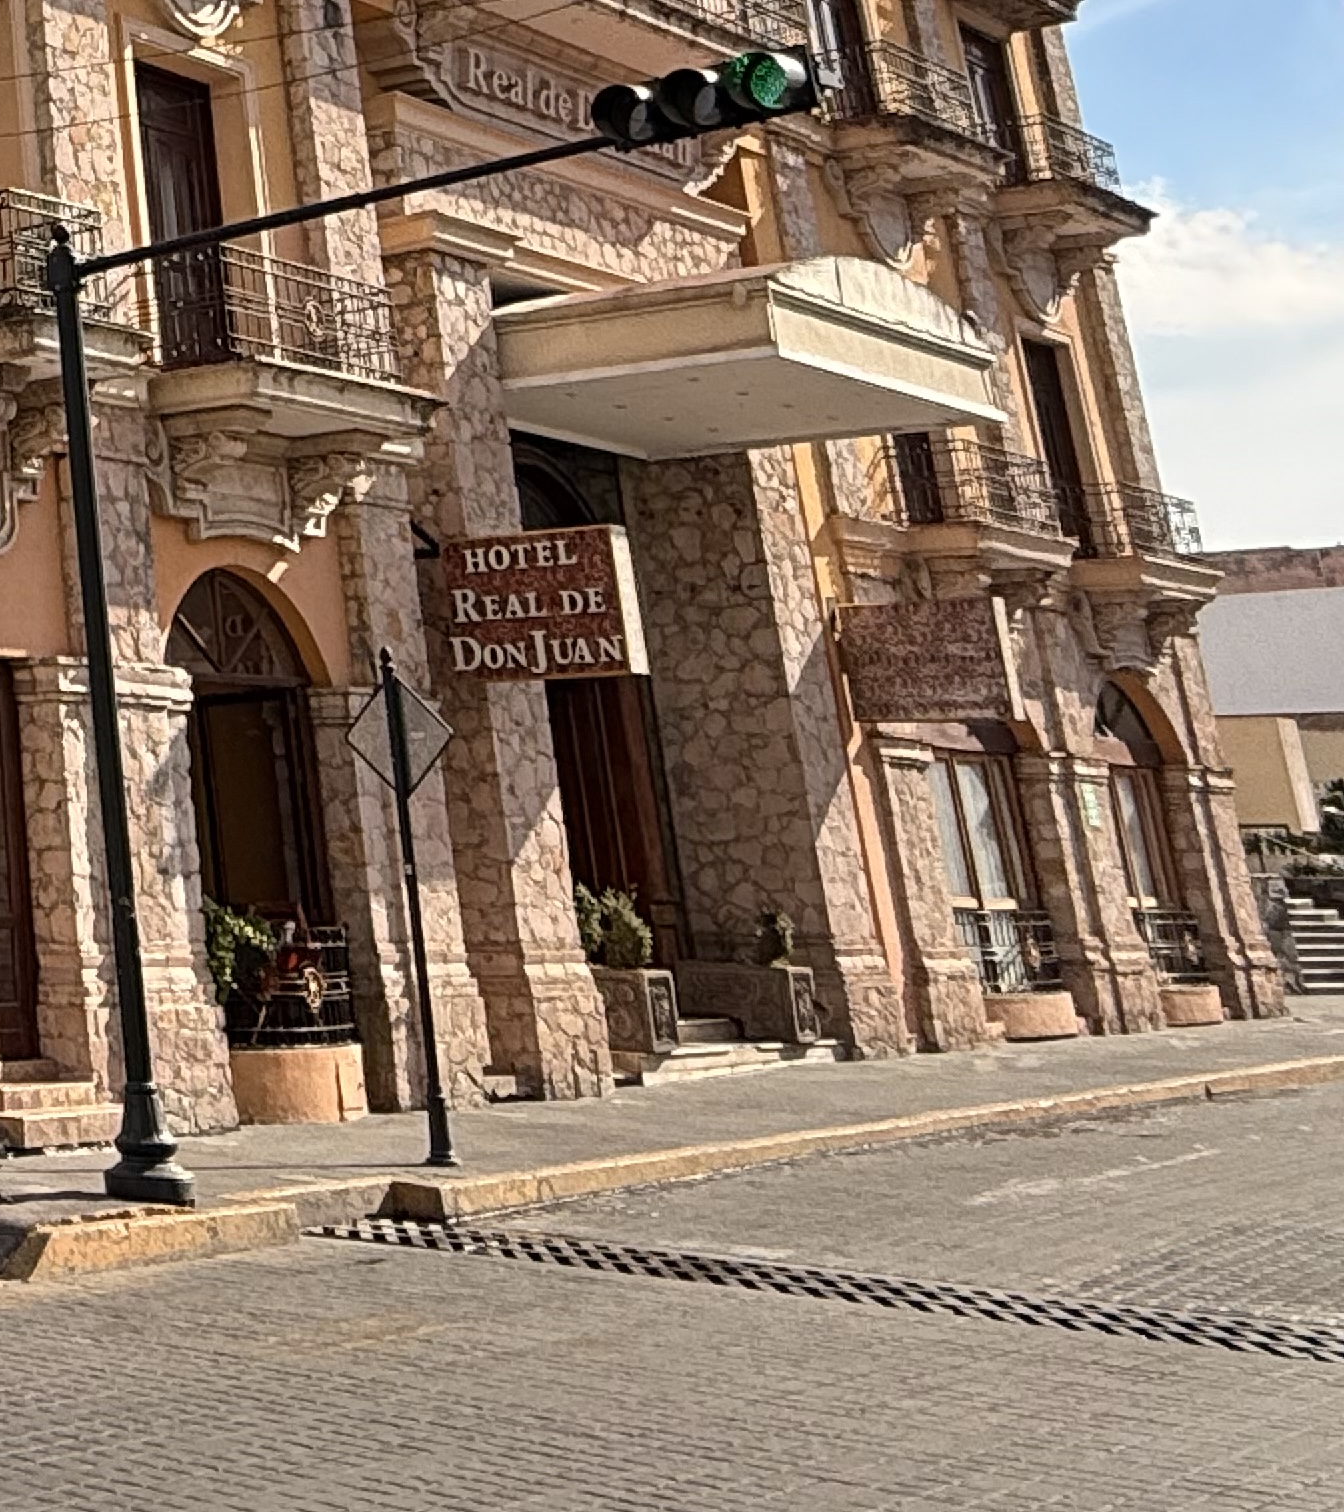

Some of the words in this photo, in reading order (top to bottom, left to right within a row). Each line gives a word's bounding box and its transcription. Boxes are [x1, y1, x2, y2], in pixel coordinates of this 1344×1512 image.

[467, 48, 535, 111] Real
[539, 79, 574, 123] de
[463, 540, 578, 574] HOTEL
[451, 588, 548, 624] REAL
[559, 587, 607, 616] DE
[449, 636, 528, 672] DON
[529, 630, 624, 674] JUAN
